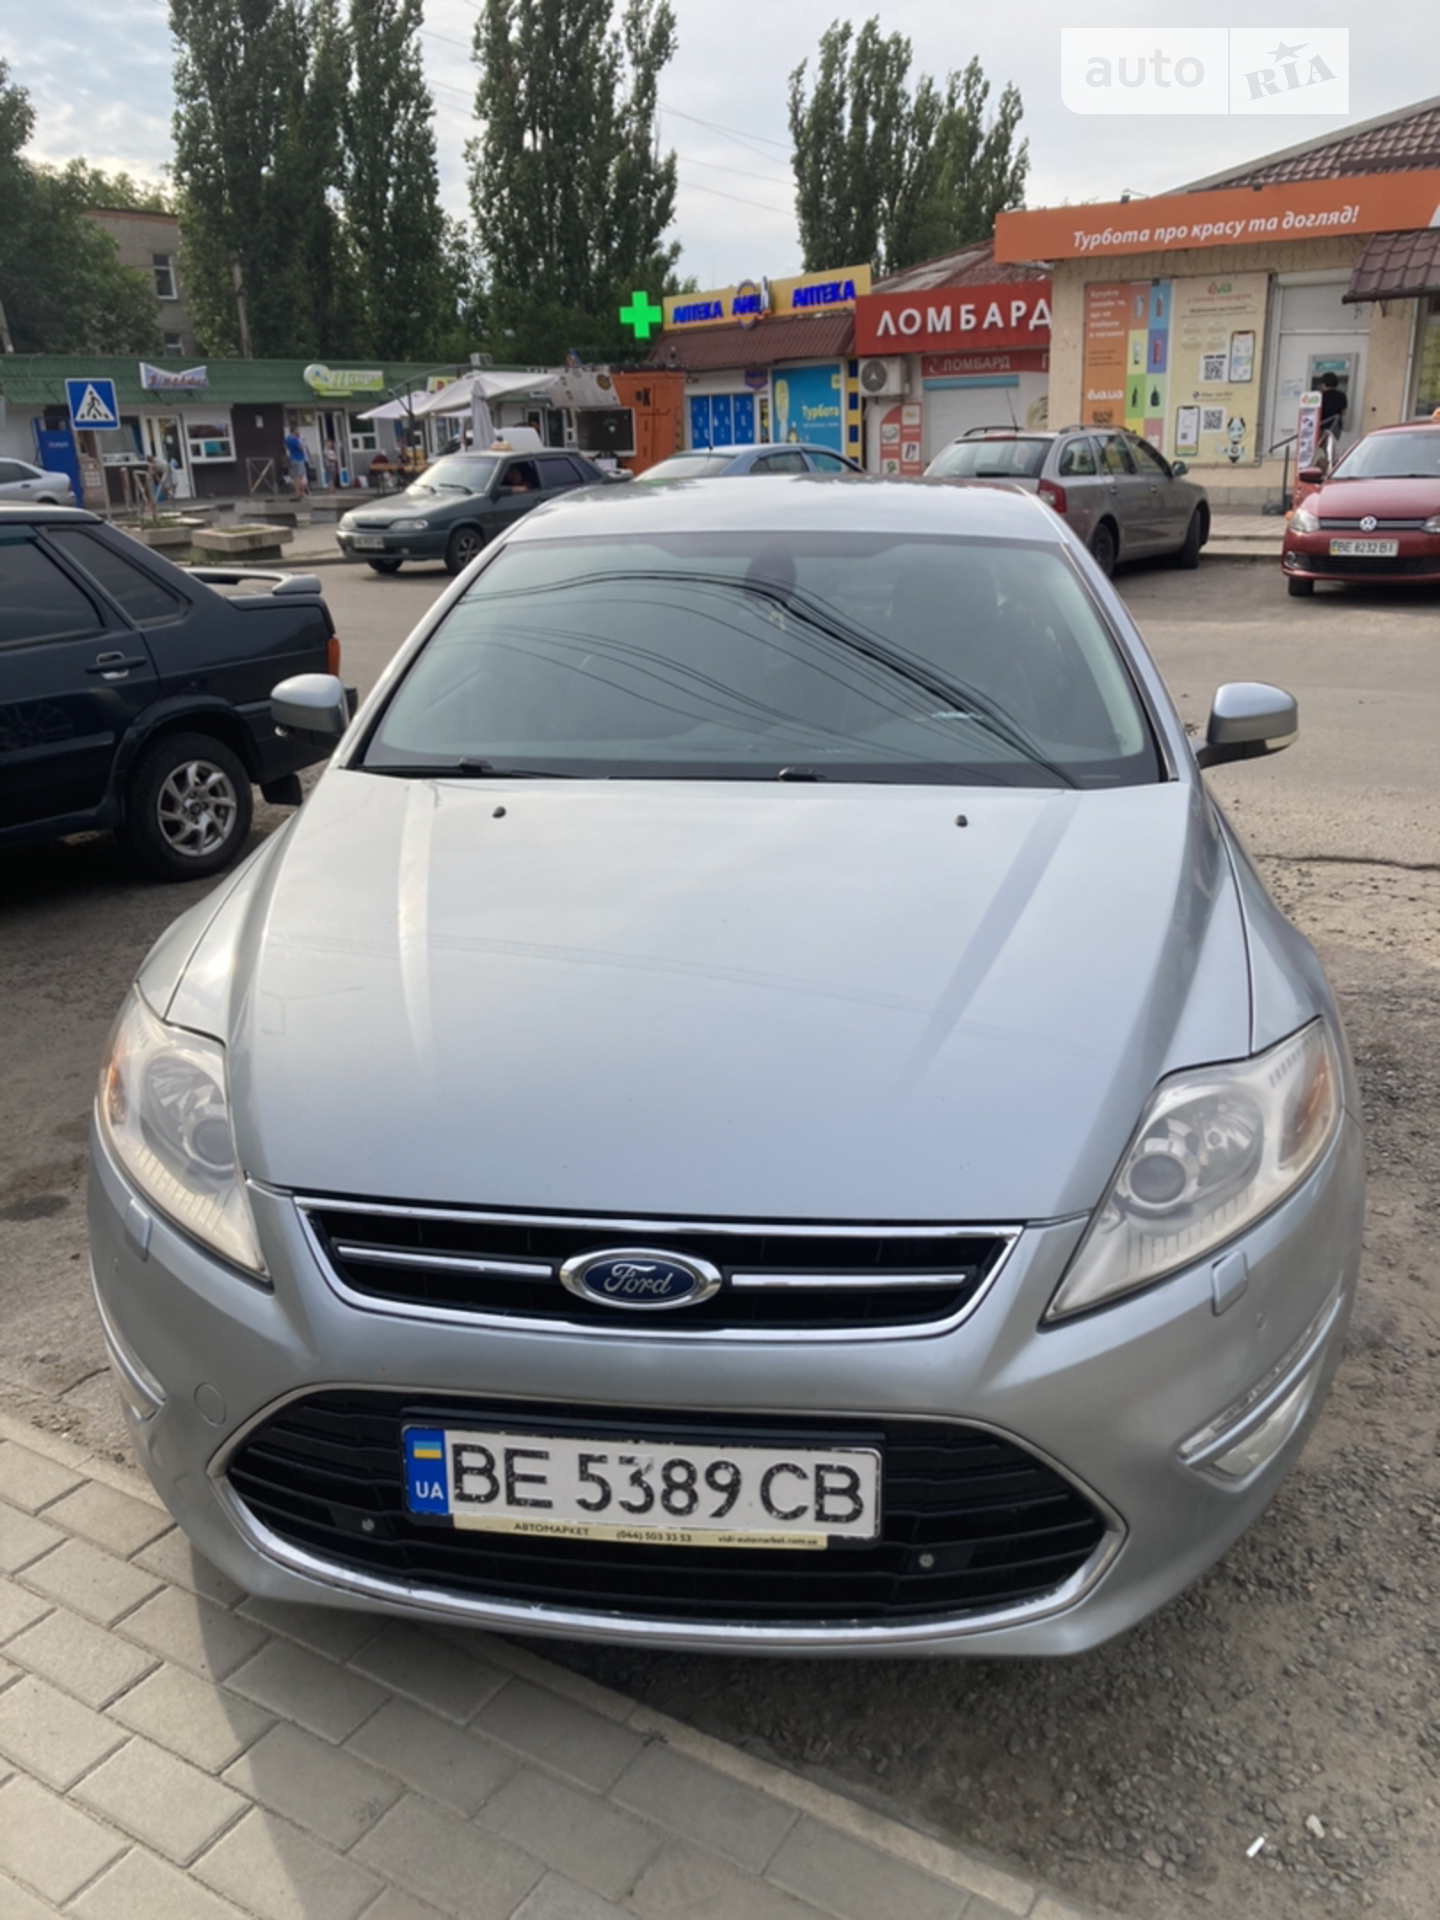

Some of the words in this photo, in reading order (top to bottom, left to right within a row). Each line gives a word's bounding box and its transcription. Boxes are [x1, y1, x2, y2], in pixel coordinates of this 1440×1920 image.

[1073, 227, 1150, 251] Турбота
[1154, 225, 1186, 244] про
[1191, 217, 1245, 240] красу
[1248, 215, 1277, 233] та
[1282, 205, 1360, 230] догляд!
[672, 300, 724, 324] АПТЕКА
[792, 279, 857, 308] АПТЕКА
[876, 298, 1051, 337] ЛОМБАРД
[943, 355, 1011, 372] ЛОМБАРД
[604, 1263, 674, 1294] Ford
[415, 1480, 445, 1500] UA
[451, 1443, 553, 1509] BE
[575, 1453, 742, 1518] 5389
[760, 1462, 864, 1524] CB
[513, 1522, 590, 1537] АВТОМАРКЕТ
[645, 1531, 663, 1541] 503
[679, 1533, 692, 1543] 53
